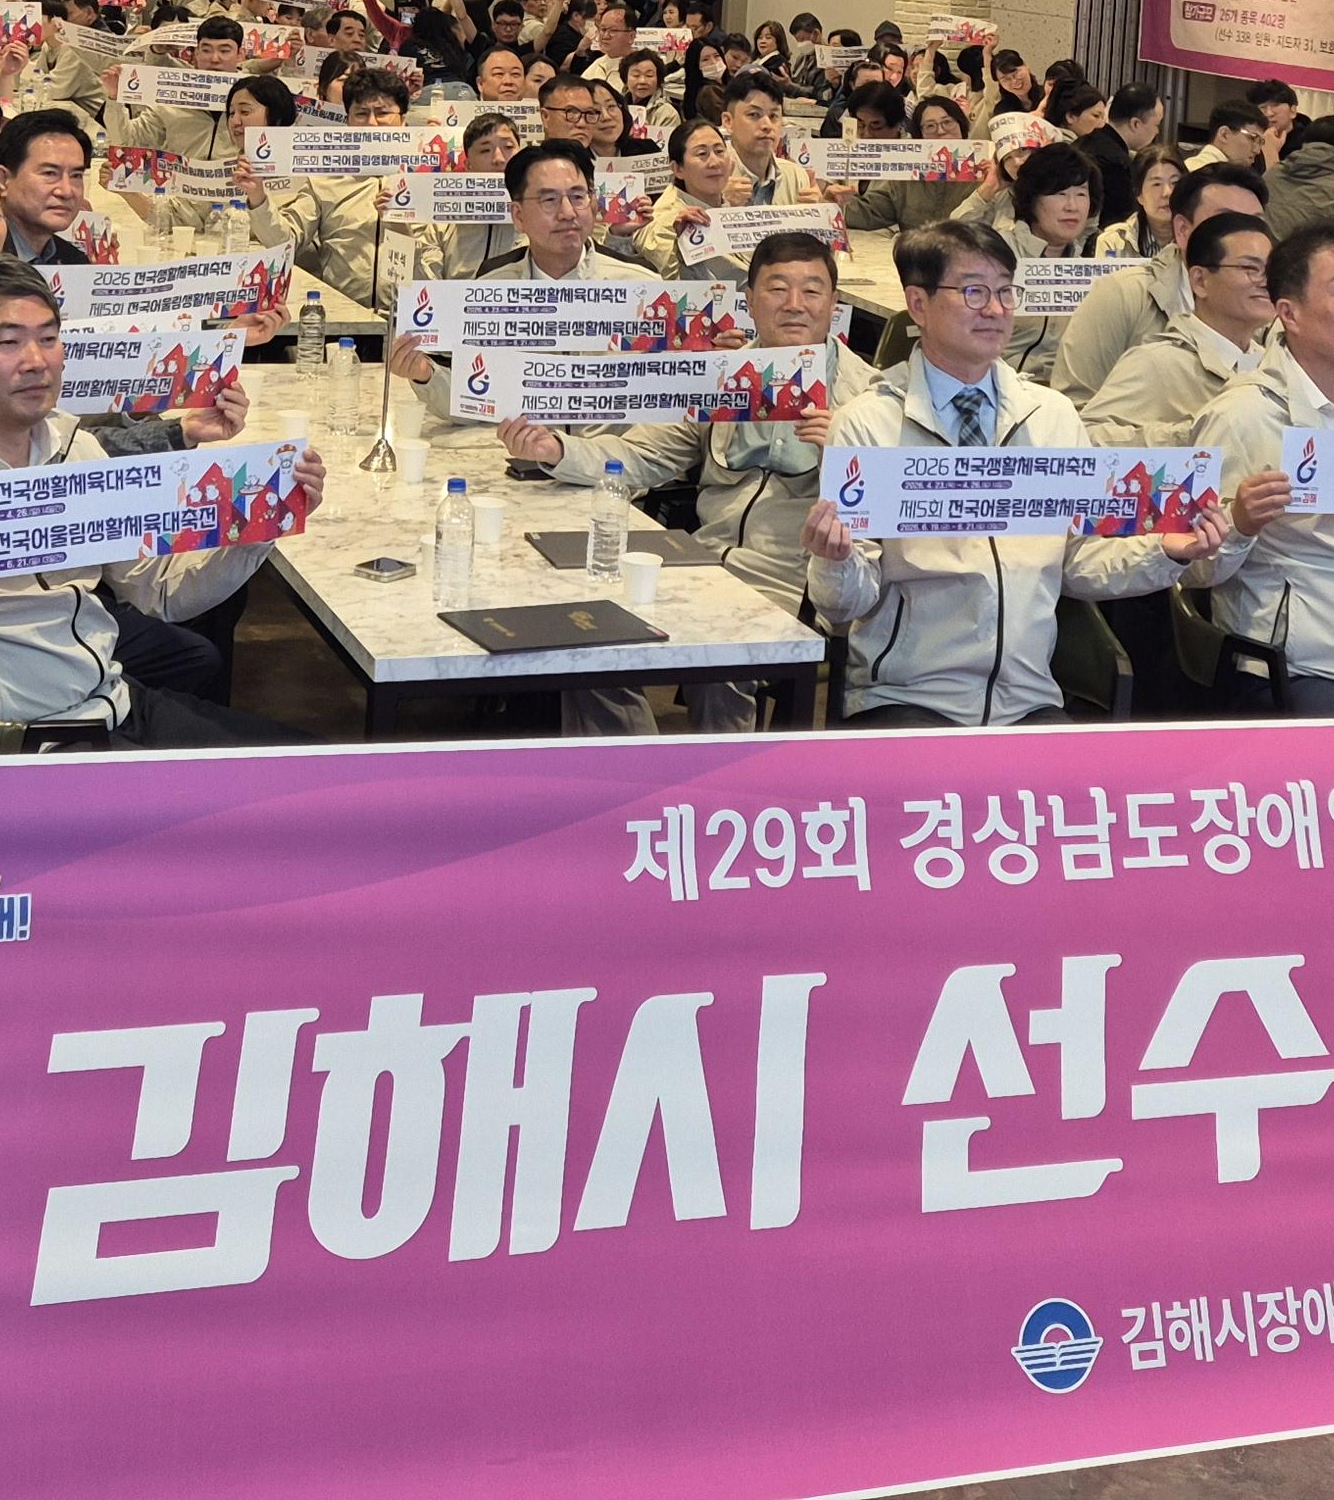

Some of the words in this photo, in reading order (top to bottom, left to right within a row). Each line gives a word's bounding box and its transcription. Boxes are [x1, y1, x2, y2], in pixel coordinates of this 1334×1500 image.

[93, 272, 131, 286] 2026
[134, 261, 232, 285] 전국생활체육대축전
[89, 301, 125, 317] 제5회
[128, 287, 259, 314] 전국어울림생활체육대축전
[465, 288, 503, 303] 2026
[507, 287, 627, 304] 전국생활체육대축전
[463, 320, 501, 336] 제5회
[504, 320, 665, 337] 전국어울림생활체육대축전
[524, 361, 567, 378] 2026
[571, 359, 707, 379] 전국생활체육대축전
[522, 393, 563, 411] 제5회
[568, 391, 749, 410] 전국어울림생활체육대축전
[904, 457, 949, 477] 2026
[954, 456, 1097, 477] 전국생활체육대축전
[899, 500, 944, 519] 제5회
[948, 498, 1137, 519] 전국어울림생활체육대축전
[623, 797, 872, 901] 제29회
[28, 970, 829, 1307] 김해시
